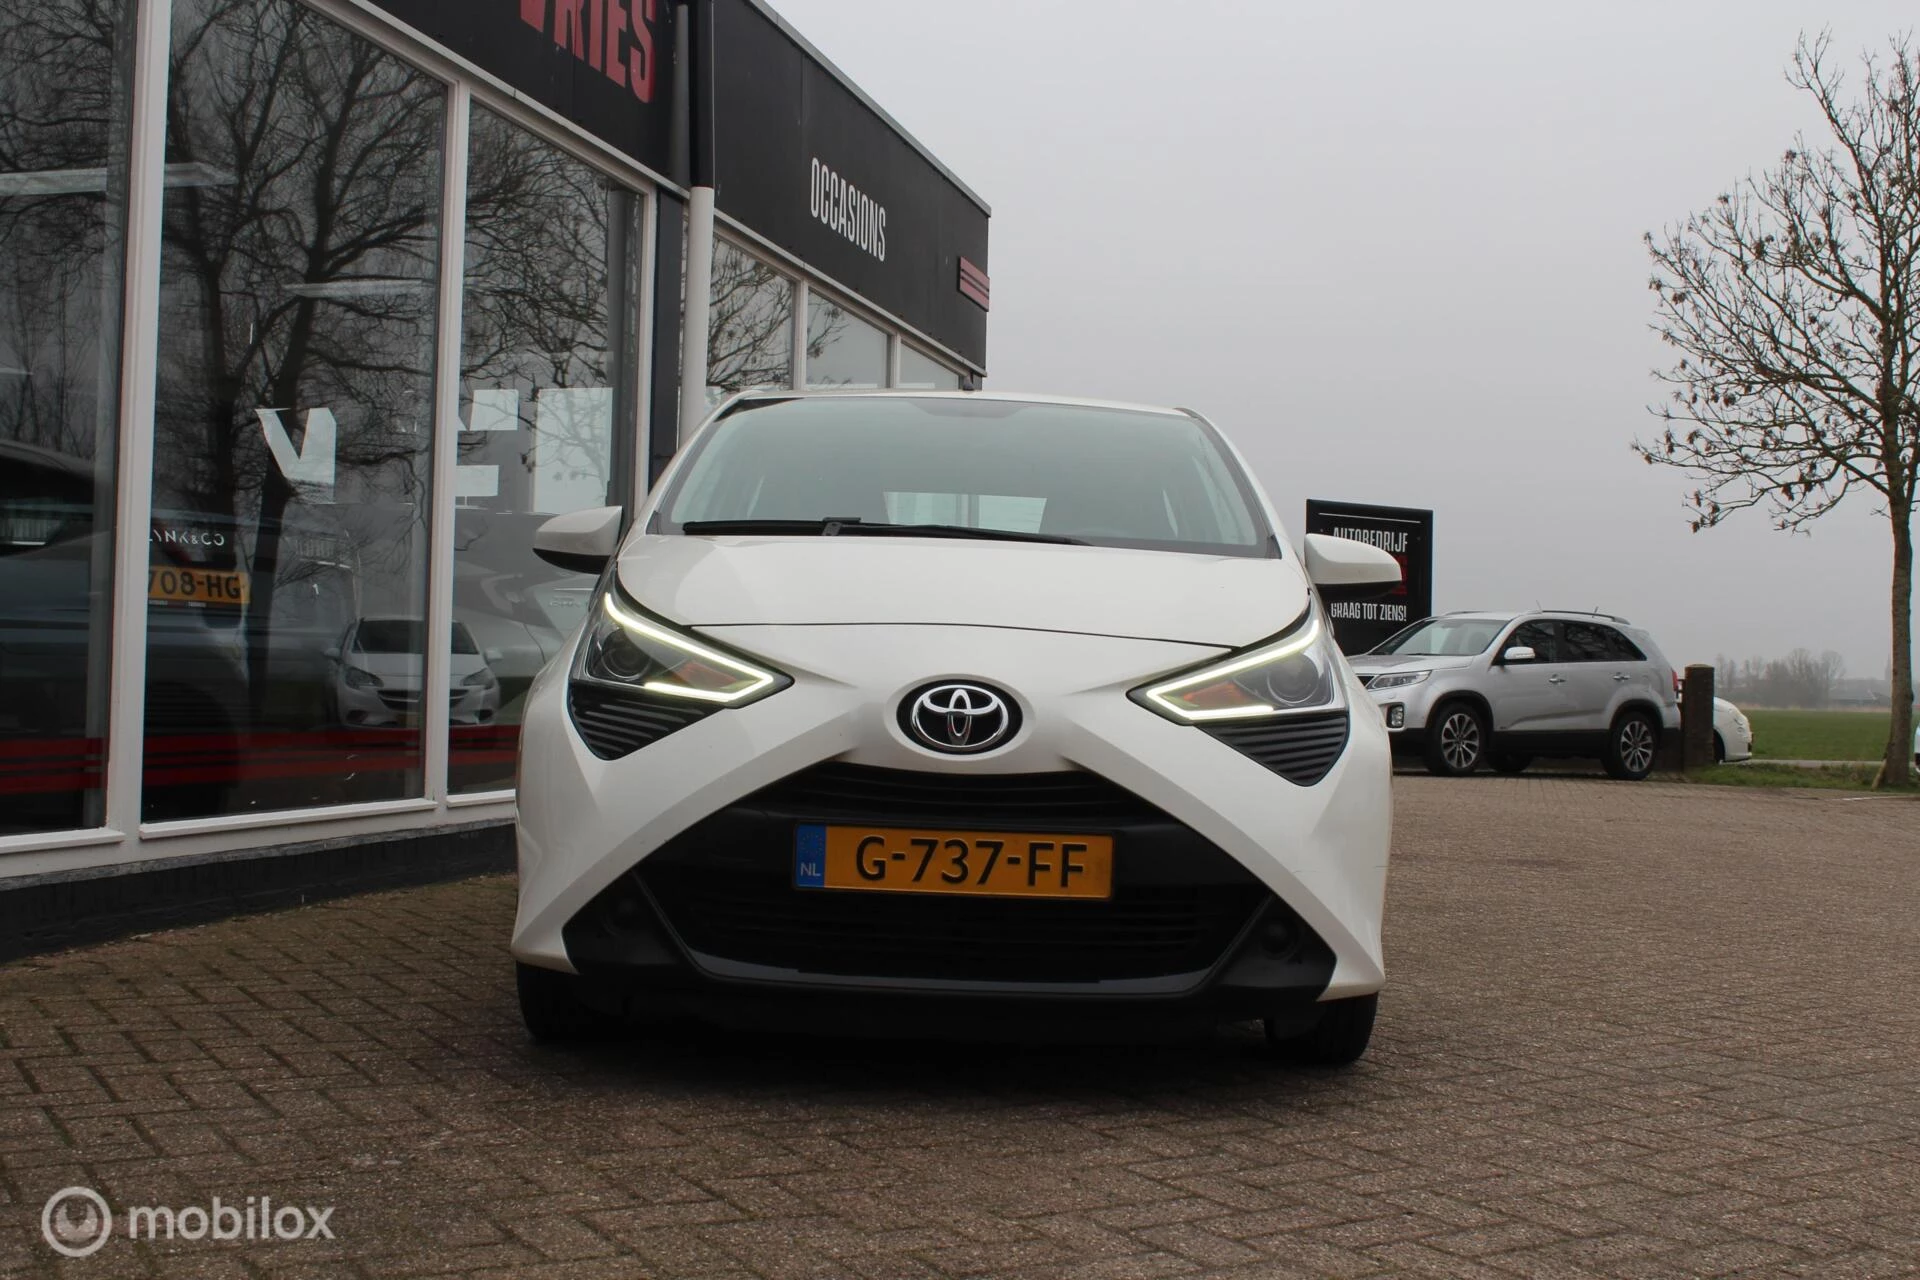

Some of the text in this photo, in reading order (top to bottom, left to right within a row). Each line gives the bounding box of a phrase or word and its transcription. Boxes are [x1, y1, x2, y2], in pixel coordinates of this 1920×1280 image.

[520, 0, 656, 103] IES
[811, 157, 886, 262] OCCASIONS
[148, 528, 225, 546] YNK&CO
[1330, 602, 1407, 621] GRAAG TOT ZIENS!
[800, 835, 1088, 888] NL G-737-FF
